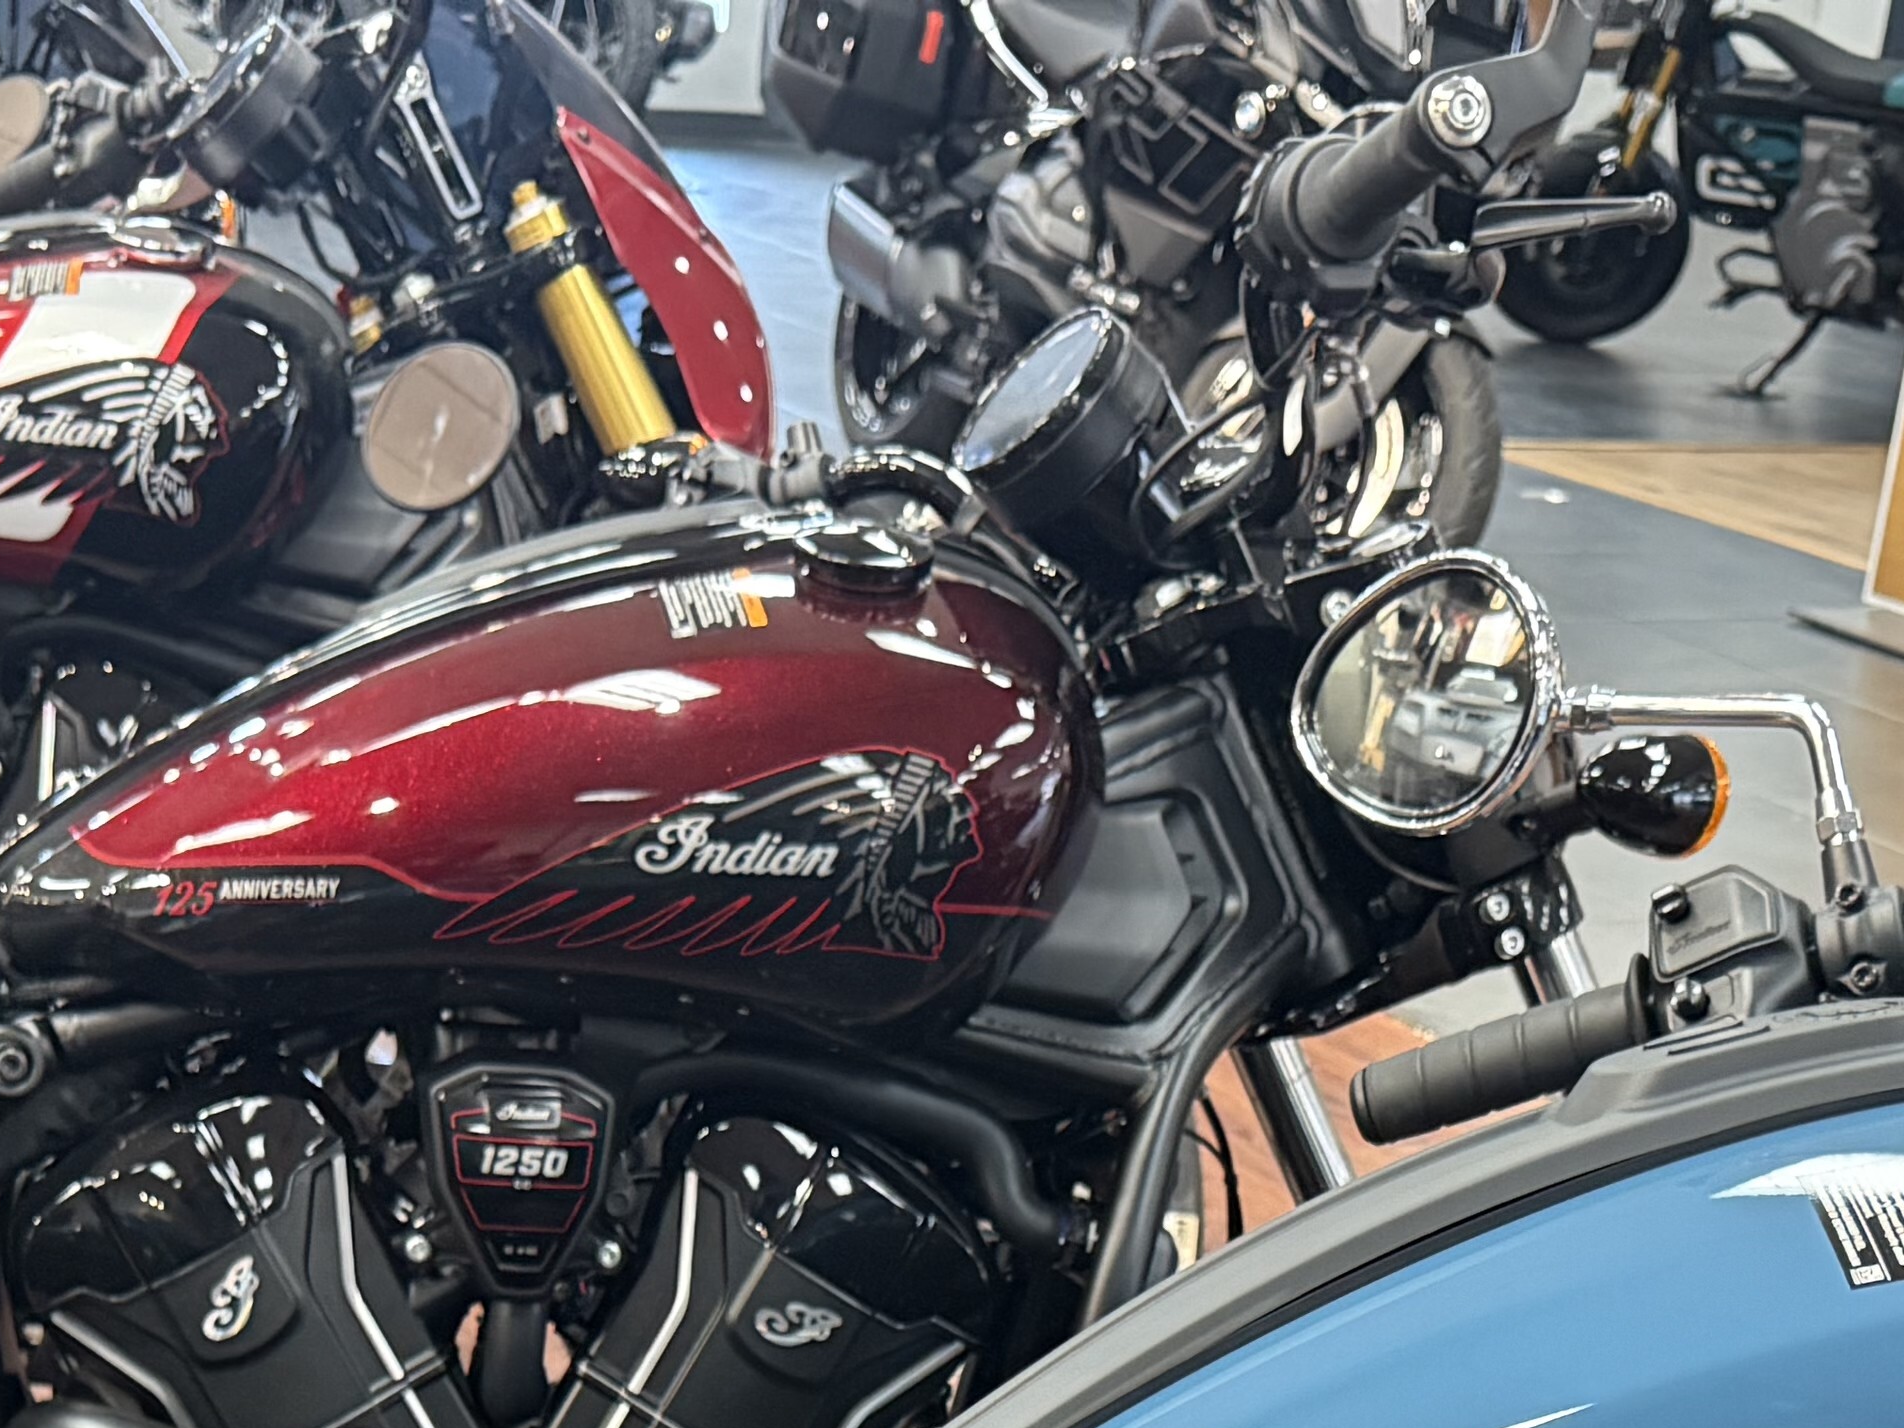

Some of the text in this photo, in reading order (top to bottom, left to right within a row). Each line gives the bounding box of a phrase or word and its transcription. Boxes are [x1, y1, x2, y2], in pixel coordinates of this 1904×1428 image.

[634, 813, 839, 878] Indian
[153, 877, 341, 916] 125 ANNIVERSARY
[480, 1145, 568, 1178] 1250
